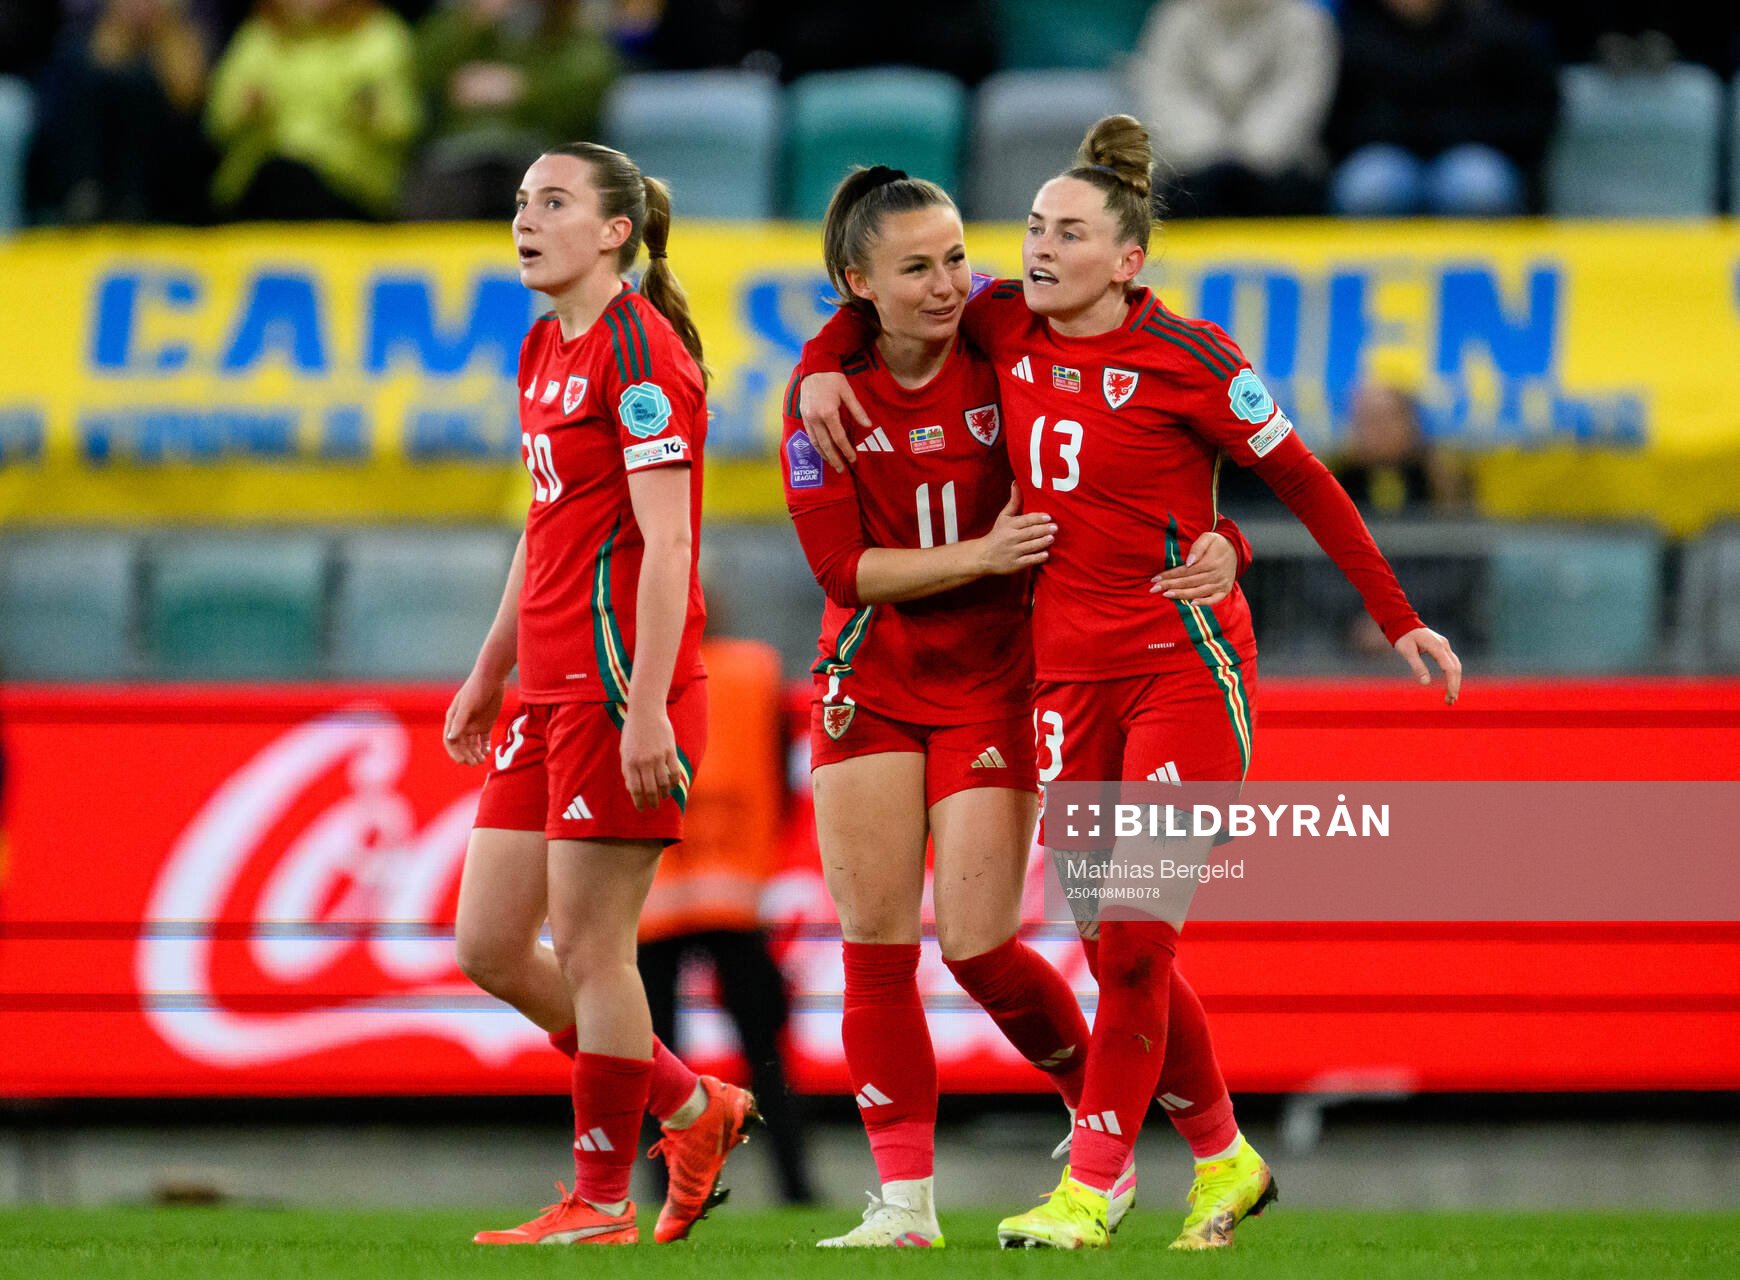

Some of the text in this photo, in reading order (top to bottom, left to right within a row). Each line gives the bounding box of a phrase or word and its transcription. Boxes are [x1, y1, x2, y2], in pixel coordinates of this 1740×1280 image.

[88, 267, 537, 377] CAM
[522, 432, 563, 503] 20
[1030, 415, 1084, 492] 13
[915, 480, 959, 549] 11
